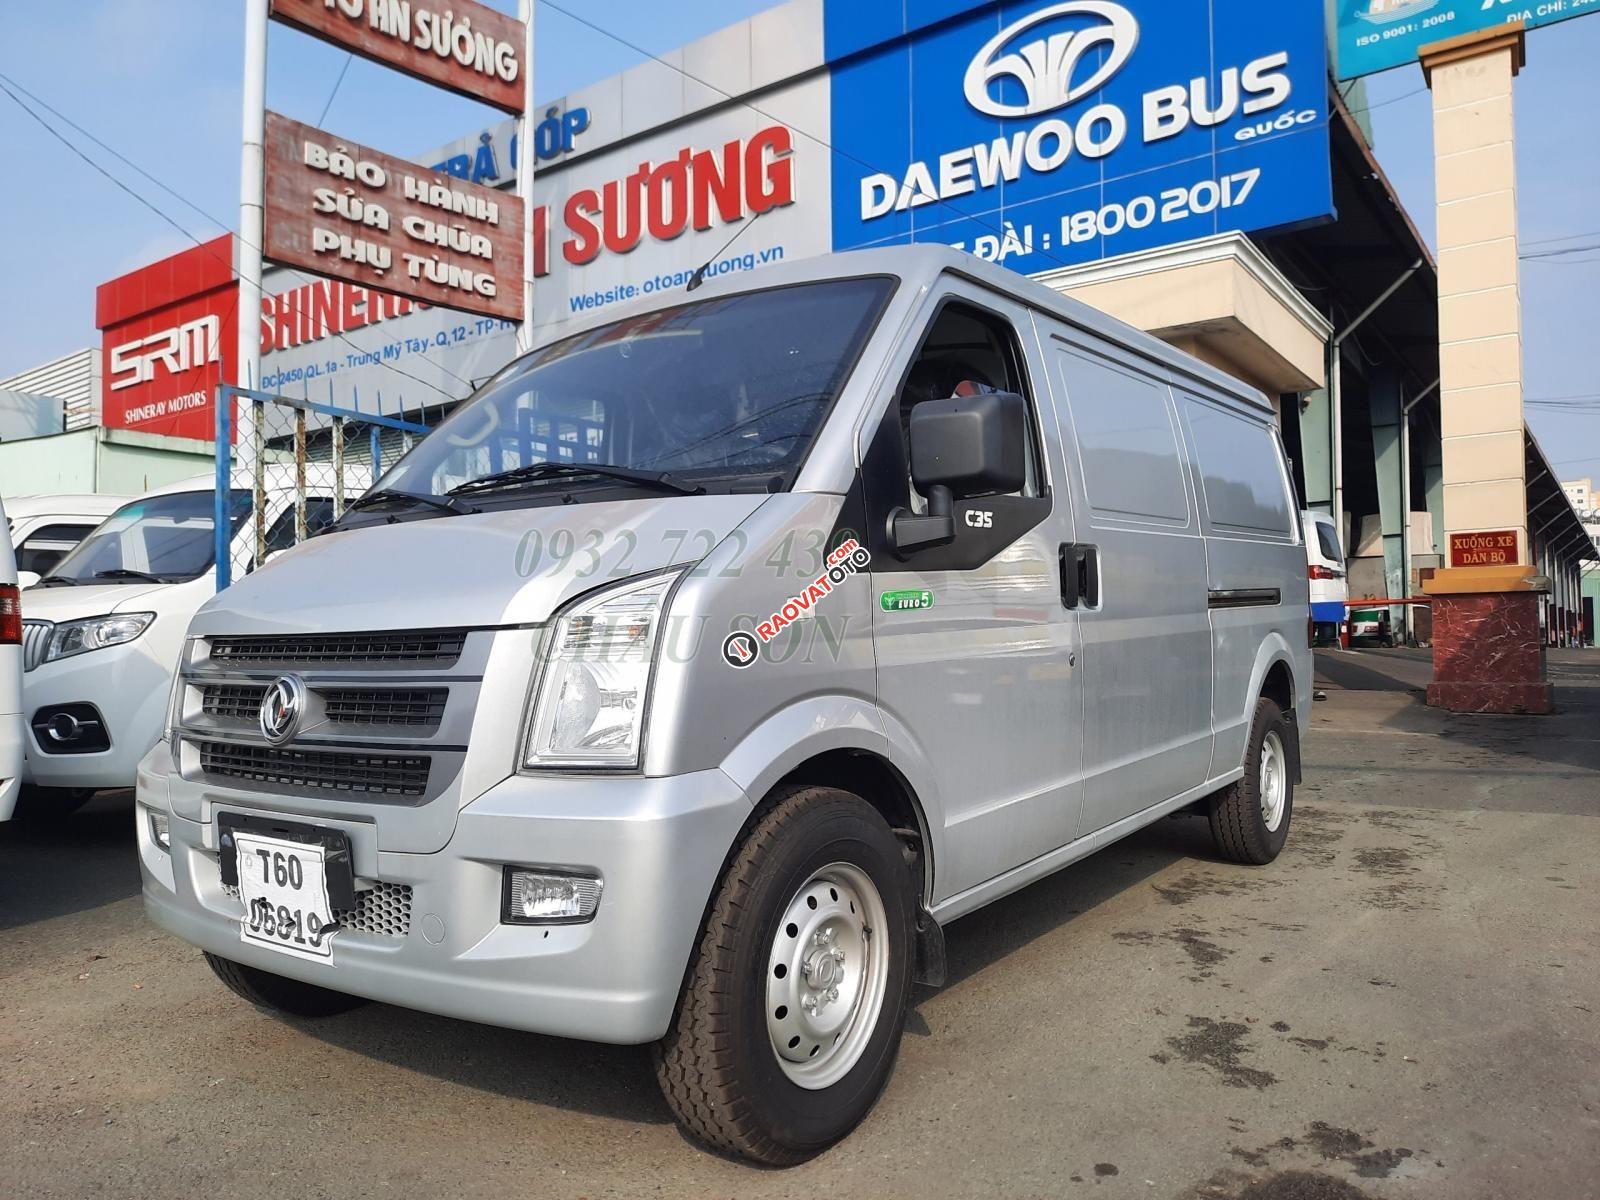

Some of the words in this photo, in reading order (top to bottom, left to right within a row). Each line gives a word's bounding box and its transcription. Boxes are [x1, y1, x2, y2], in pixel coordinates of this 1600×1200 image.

[1356, 33, 1380, 46] ISO
[1422, 11, 1456, 28] 2008
[430, 132, 499, 184] RẢ
[860, 103, 1126, 222] DAEWOO
[1143, 52, 1292, 143] BUS
[304, 141, 386, 188] BẢO
[404, 175, 499, 225] HÀNH
[562, 126, 795, 267] SƯƠNG
[1061, 196, 1156, 246] 1800
[1161, 168, 1261, 222] 2017
[313, 187, 389, 231] SỬA
[402, 216, 492, 259] CHỮA
[313, 228, 392, 275] PHỤ
[402, 253, 497, 297] TÙNG
[570, 284, 640, 312] Website:
[643, 246, 784, 293] otoanuong.vn
[111, 314, 220, 391] SRM
[346, 351, 380, 369] Trung
[125, 401, 167, 424] SHINERAY
[168, 390, 207, 413] MOTORS
[965, 509, 993, 528] C35
[1497, 536, 1514, 547] XE
[898, 599, 920, 609] EURO
[921, 592, 930, 608] 5
[256, 849, 304, 890] T60
